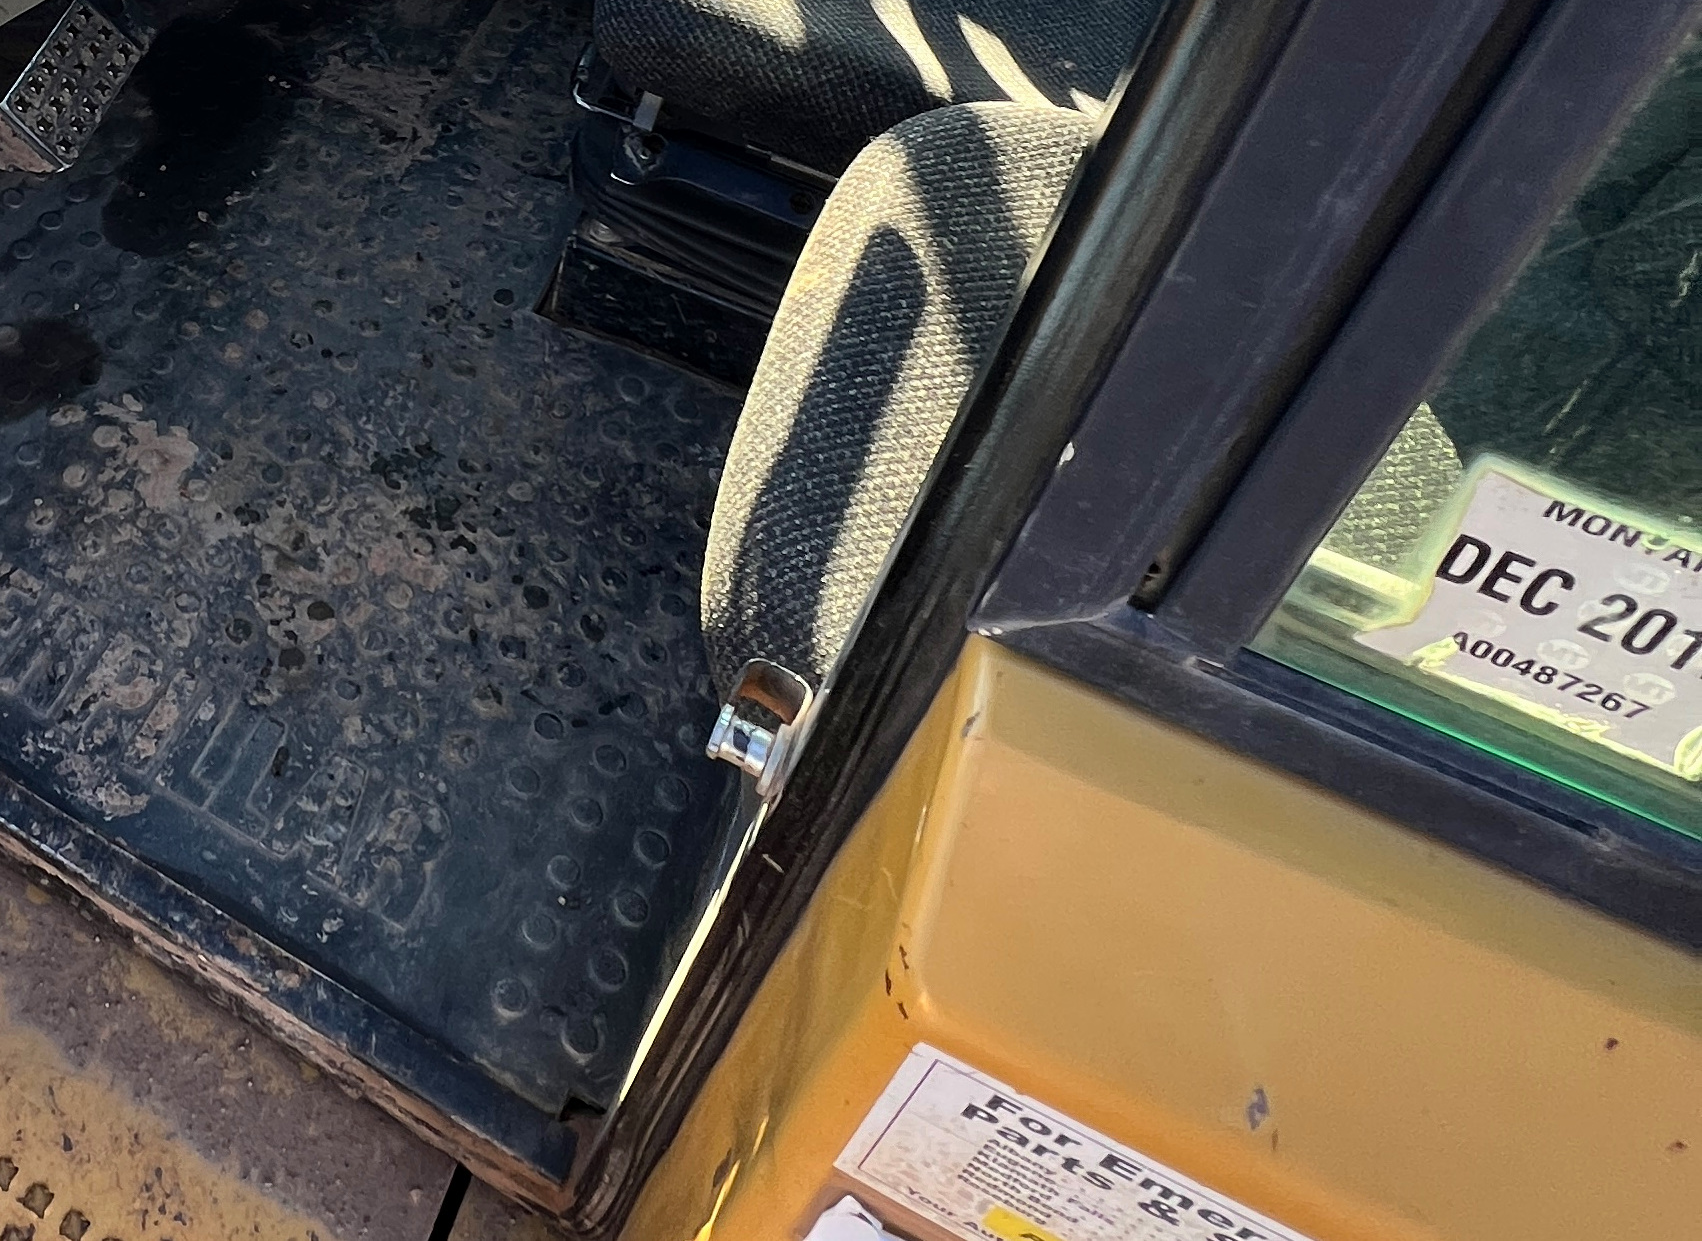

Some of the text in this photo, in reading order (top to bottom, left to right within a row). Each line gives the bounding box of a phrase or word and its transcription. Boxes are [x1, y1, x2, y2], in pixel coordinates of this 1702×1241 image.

[1543, 500, 1702, 572] MONA
[1435, 533, 1702, 679] DEC 201
[1453, 631, 1651, 719] A00487267
[984, 1094, 1081, 1146] For
[961, 1103, 1179, 1226] Parts &
[986, 1138, 1057, 1175] Albany
[906, 1185, 956, 1216] Your
